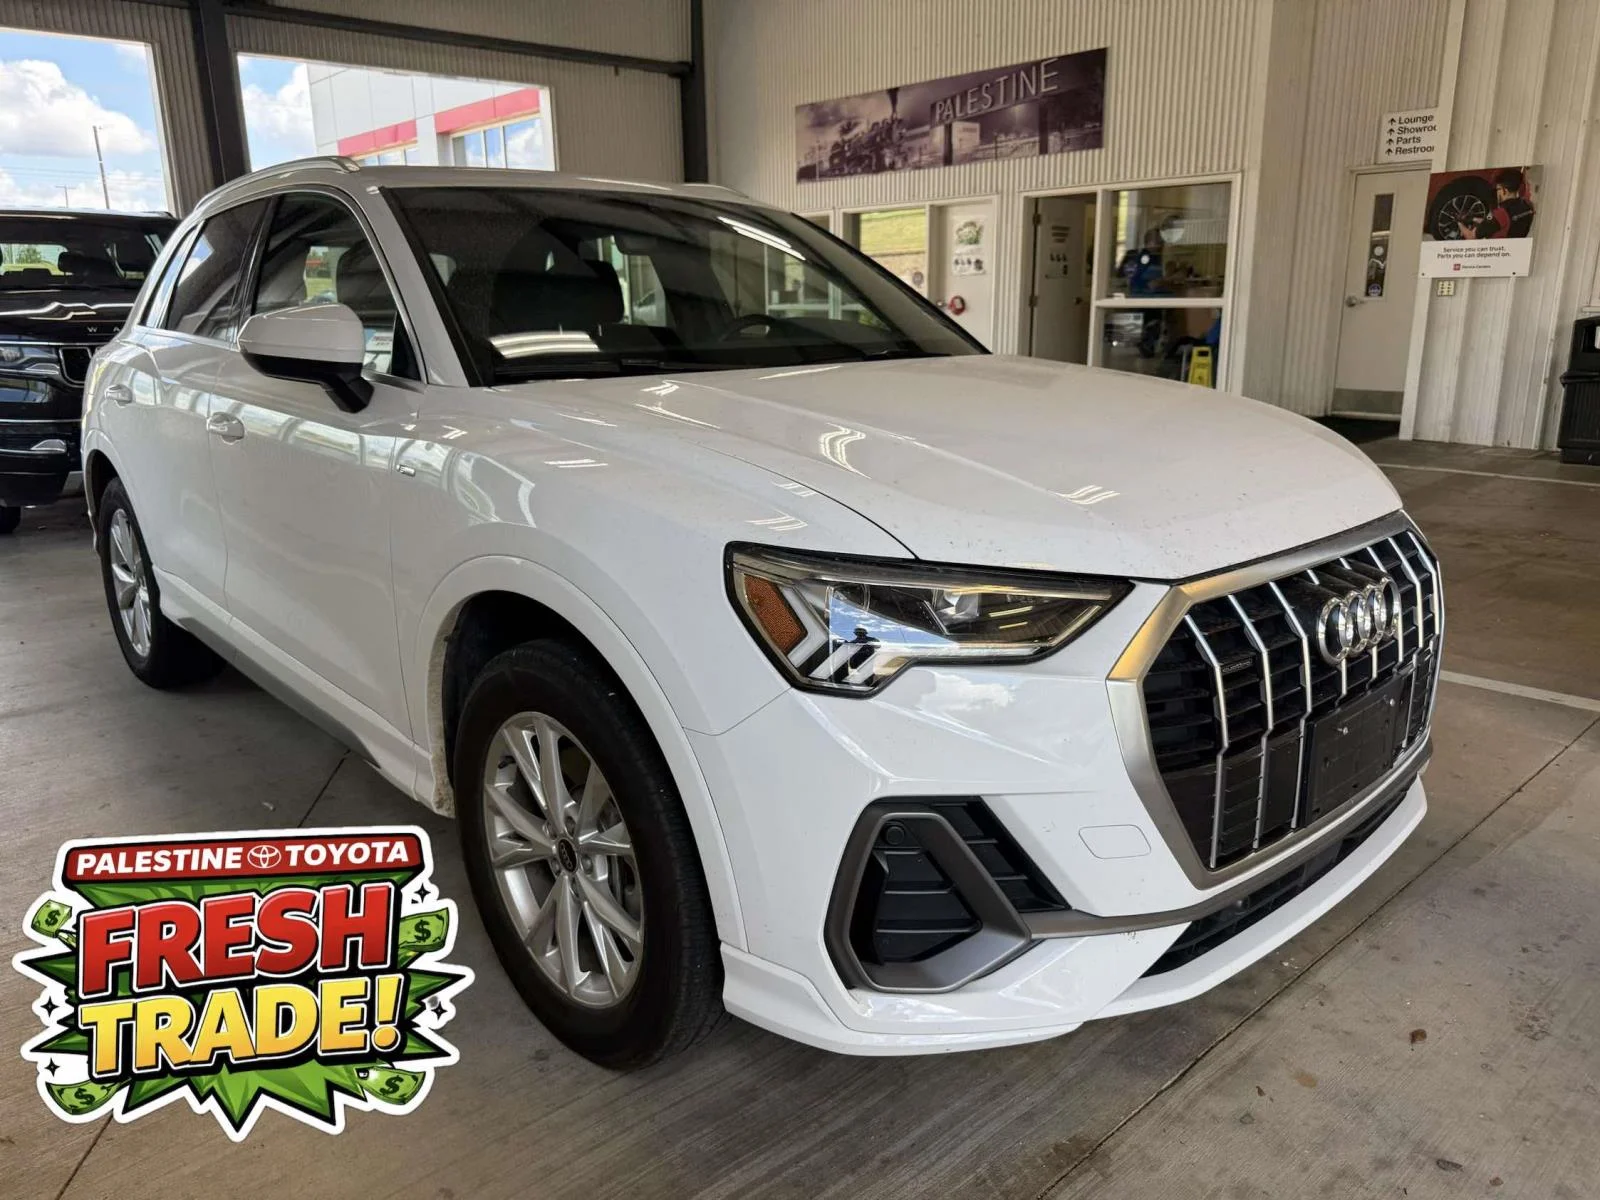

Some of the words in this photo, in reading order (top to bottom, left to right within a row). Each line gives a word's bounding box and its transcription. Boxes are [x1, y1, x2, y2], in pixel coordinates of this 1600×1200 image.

[935, 58, 1059, 123] PALESTINE
[1398, 115, 1434, 124] Lounge
[1396, 136, 1421, 145] Parts
[1395, 146, 1435, 155] Restroo
